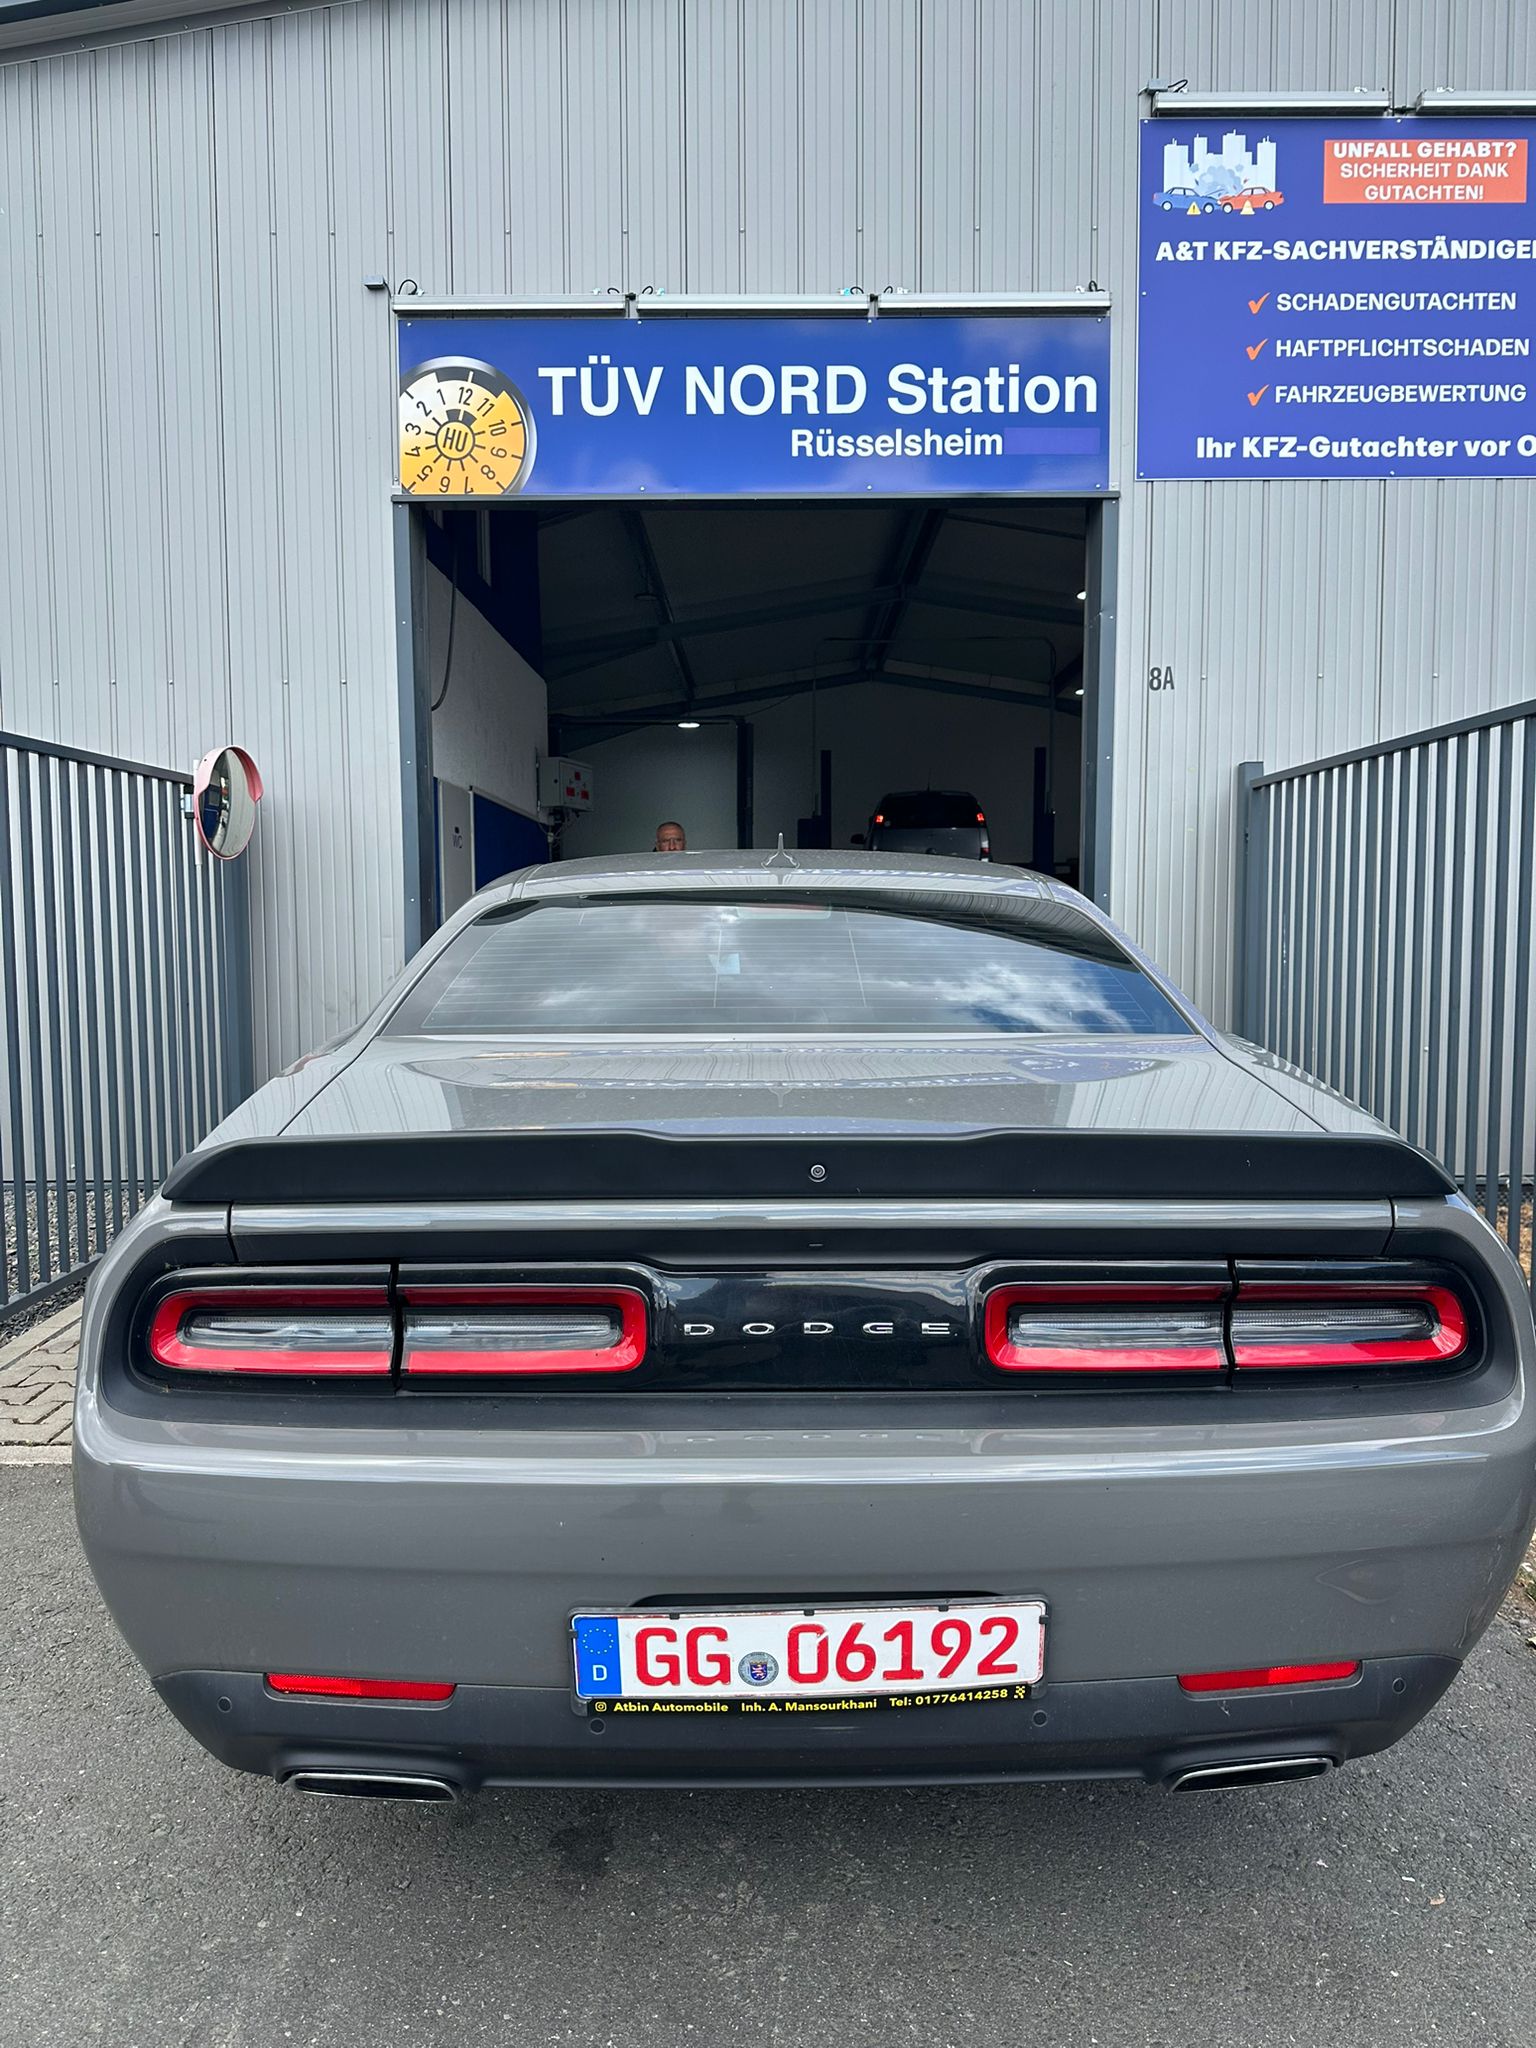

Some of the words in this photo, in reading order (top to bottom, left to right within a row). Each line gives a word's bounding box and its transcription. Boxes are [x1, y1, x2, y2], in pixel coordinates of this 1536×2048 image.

[1333, 141, 1412, 159] UNFALL
[1417, 141, 1517, 158] GEHABT?
[1340, 162, 1452, 179] SICHERHEIT
[1456, 162, 1509, 178] DANK
[1364, 184, 1484, 201] GUTACHTEN!
[1155, 241, 1209, 262] A&T
[1276, 292, 1517, 312] SCHADENGUTACHTEN
[1275, 338, 1530, 358] HAFTPFLICHTSCHADEN
[537, 355, 664, 416] TÜV
[685, 364, 867, 416] NORD
[887, 363, 1098, 414] Station
[1275, 383, 1527, 404] FAHRZEUGBEWERTUNG
[436, 388, 446, 405] 1
[458, 387, 473, 406] 12
[416, 400, 432, 417] 2
[477, 398, 495, 417] 11
[404, 422, 421, 436] 3
[488, 419, 507, 437] 10
[442, 427, 468, 452] HU
[791, 427, 1003, 457] Rüsselsheim
[1196, 436, 1237, 459] Ihr
[1242, 435, 1459, 458] KFZ-Gutachter
[1463, 439, 1512, 457] vor
[404, 445, 421, 458] 4
[416, 465, 433, 482] 5
[480, 464, 496, 480] 8
[464, 476, 474, 494] 7
[1149, 666, 1175, 691] 8A
[683, 1322, 951, 1336] DODGE
[592, 1664, 607, 1682] D
[634, 1626, 732, 1687] GG
[786, 1616, 1019, 1684] 06192
[613, 1701, 650, 1712] Atbin
[652, 1702, 729, 1712] Automobile
[741, 1702, 766, 1712] Inh.
[768, 1701, 783, 1712] A.
[785, 1698, 878, 1712] Mansourkhani
[889, 1697, 912, 1707] Tel:
[915, 1688, 1008, 1706] 01776414258
